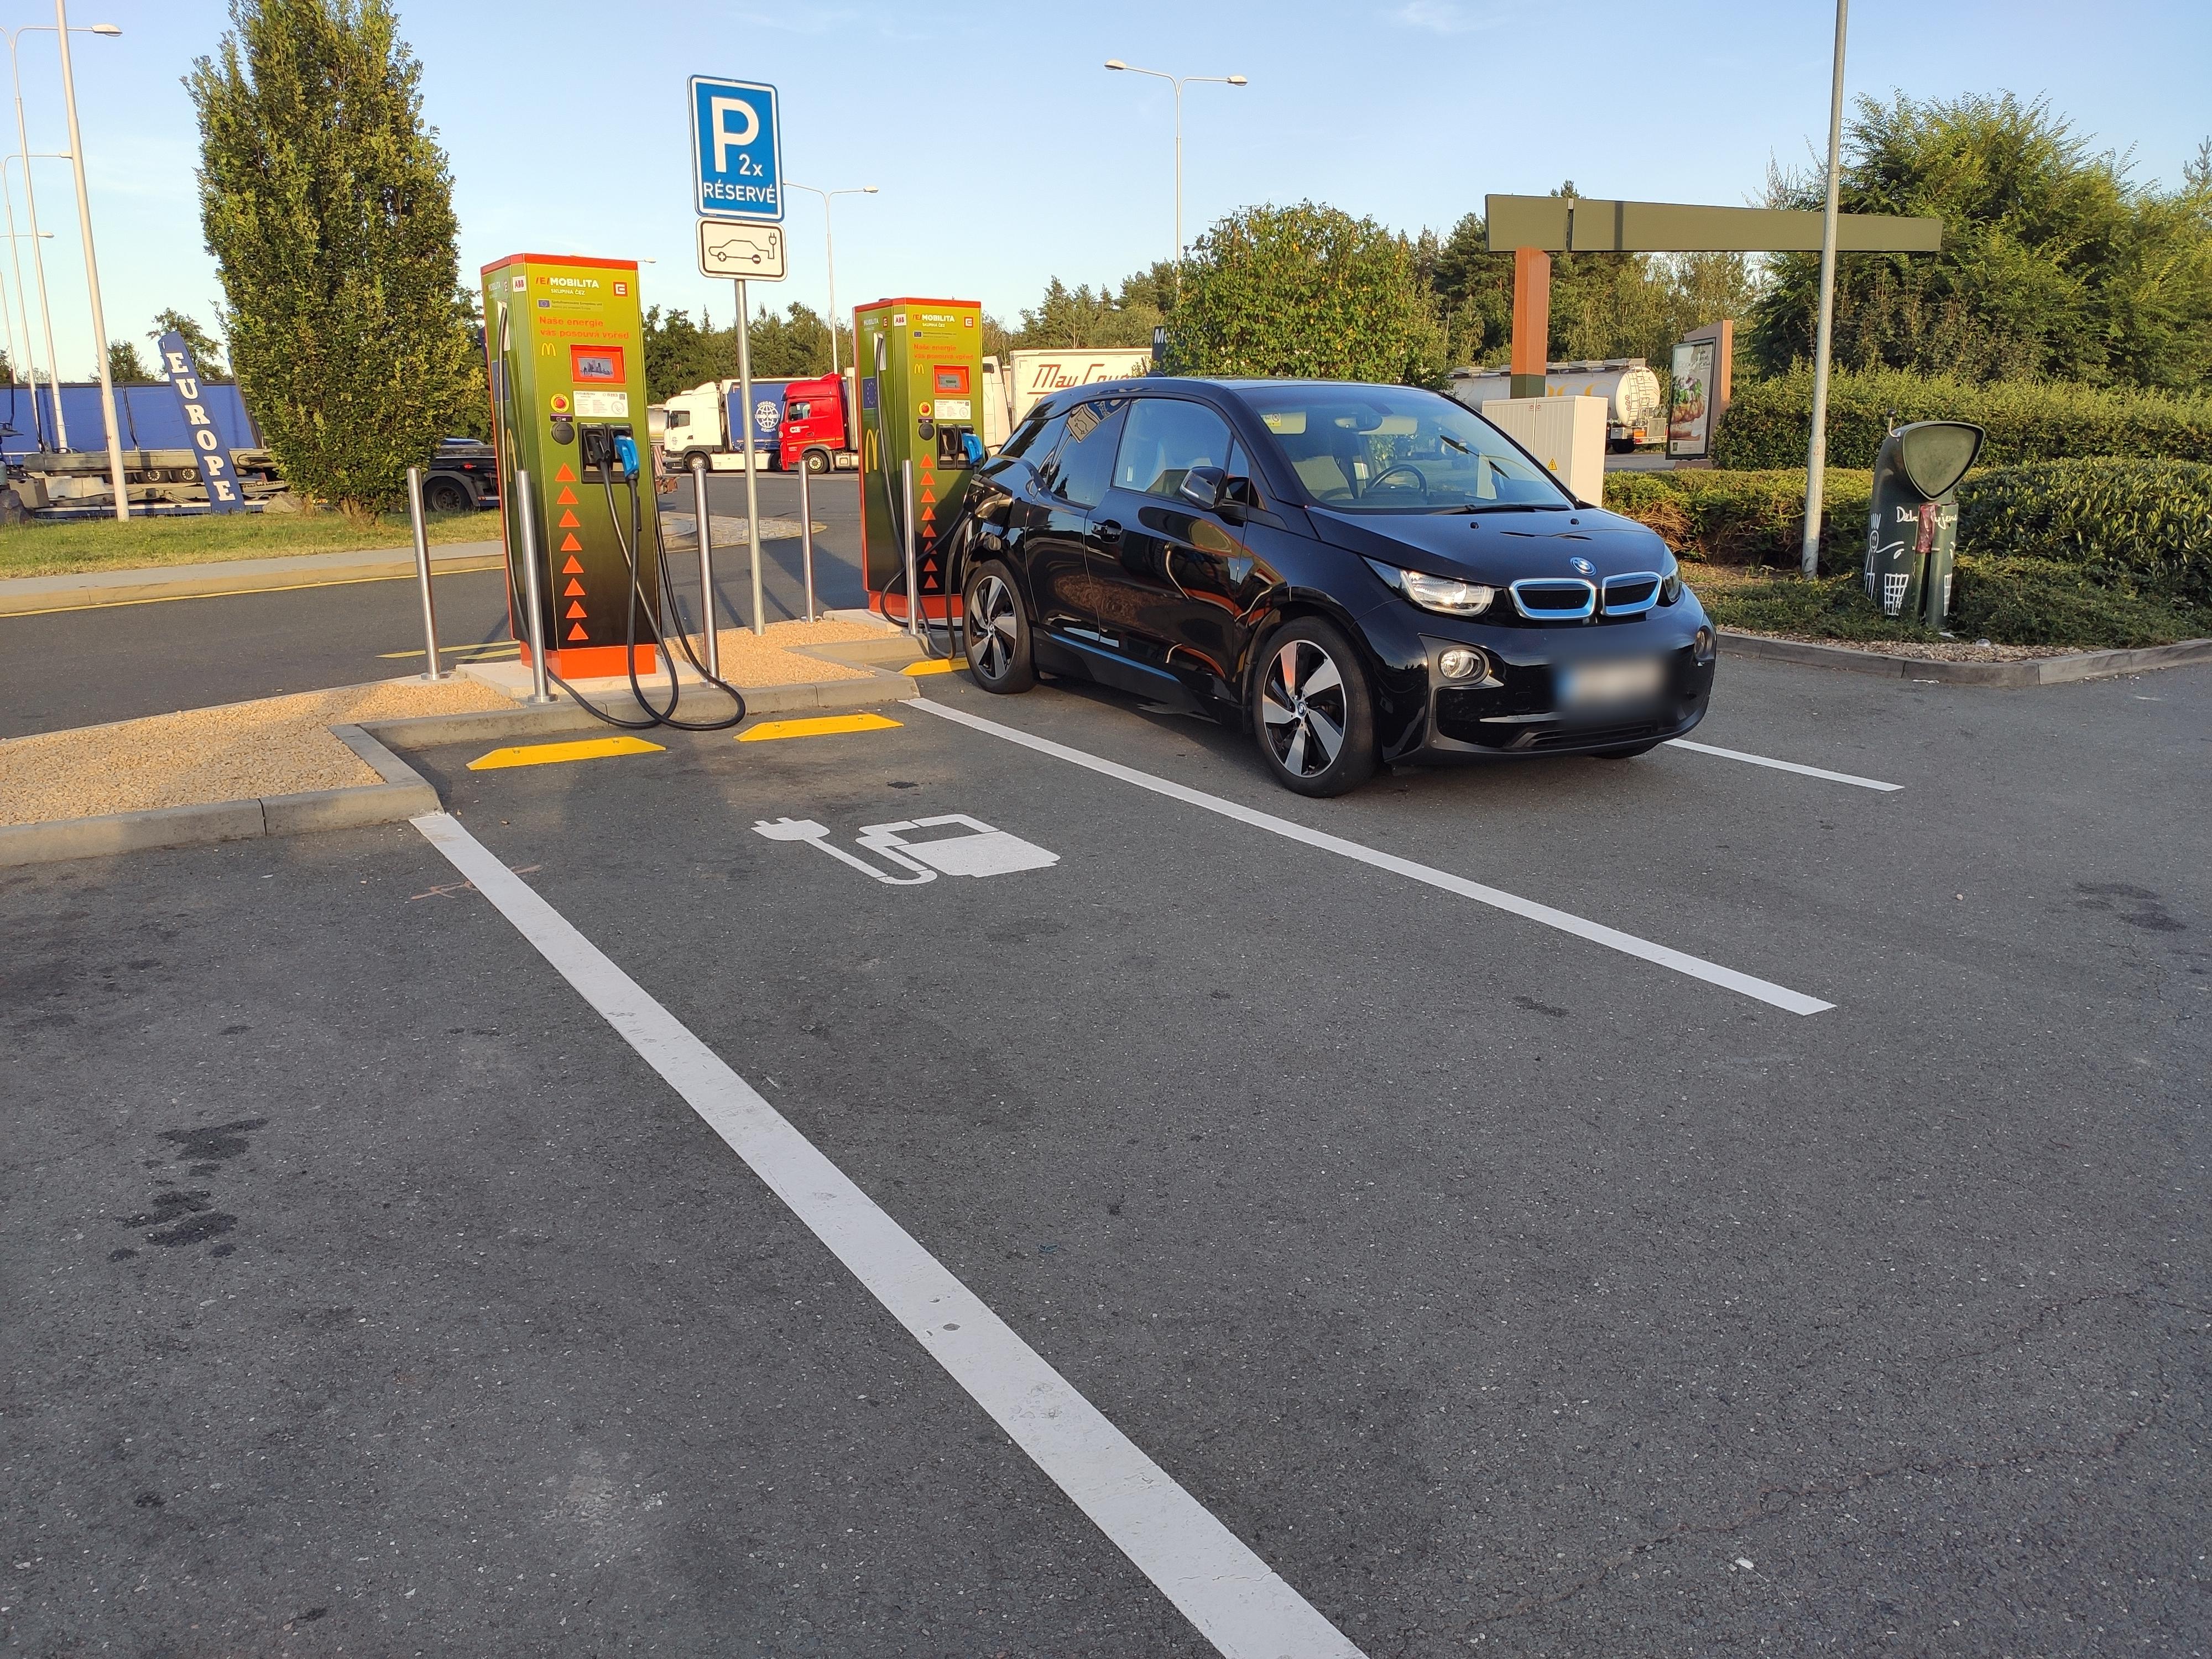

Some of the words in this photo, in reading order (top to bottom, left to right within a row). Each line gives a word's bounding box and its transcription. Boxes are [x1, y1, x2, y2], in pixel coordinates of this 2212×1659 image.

[711, 96, 759, 173] P
[739, 153, 763, 177] 2x
[703, 179, 776, 204] RÉSERVÉ
[515, 279, 524, 288] ABB
[539, 316, 564, 325] Naše
[567, 319, 603, 328] energie
[559, 330, 599, 338] posouvá
[603, 331, 629, 340] vpřed
[166, 352, 236, 501] EUROPE
